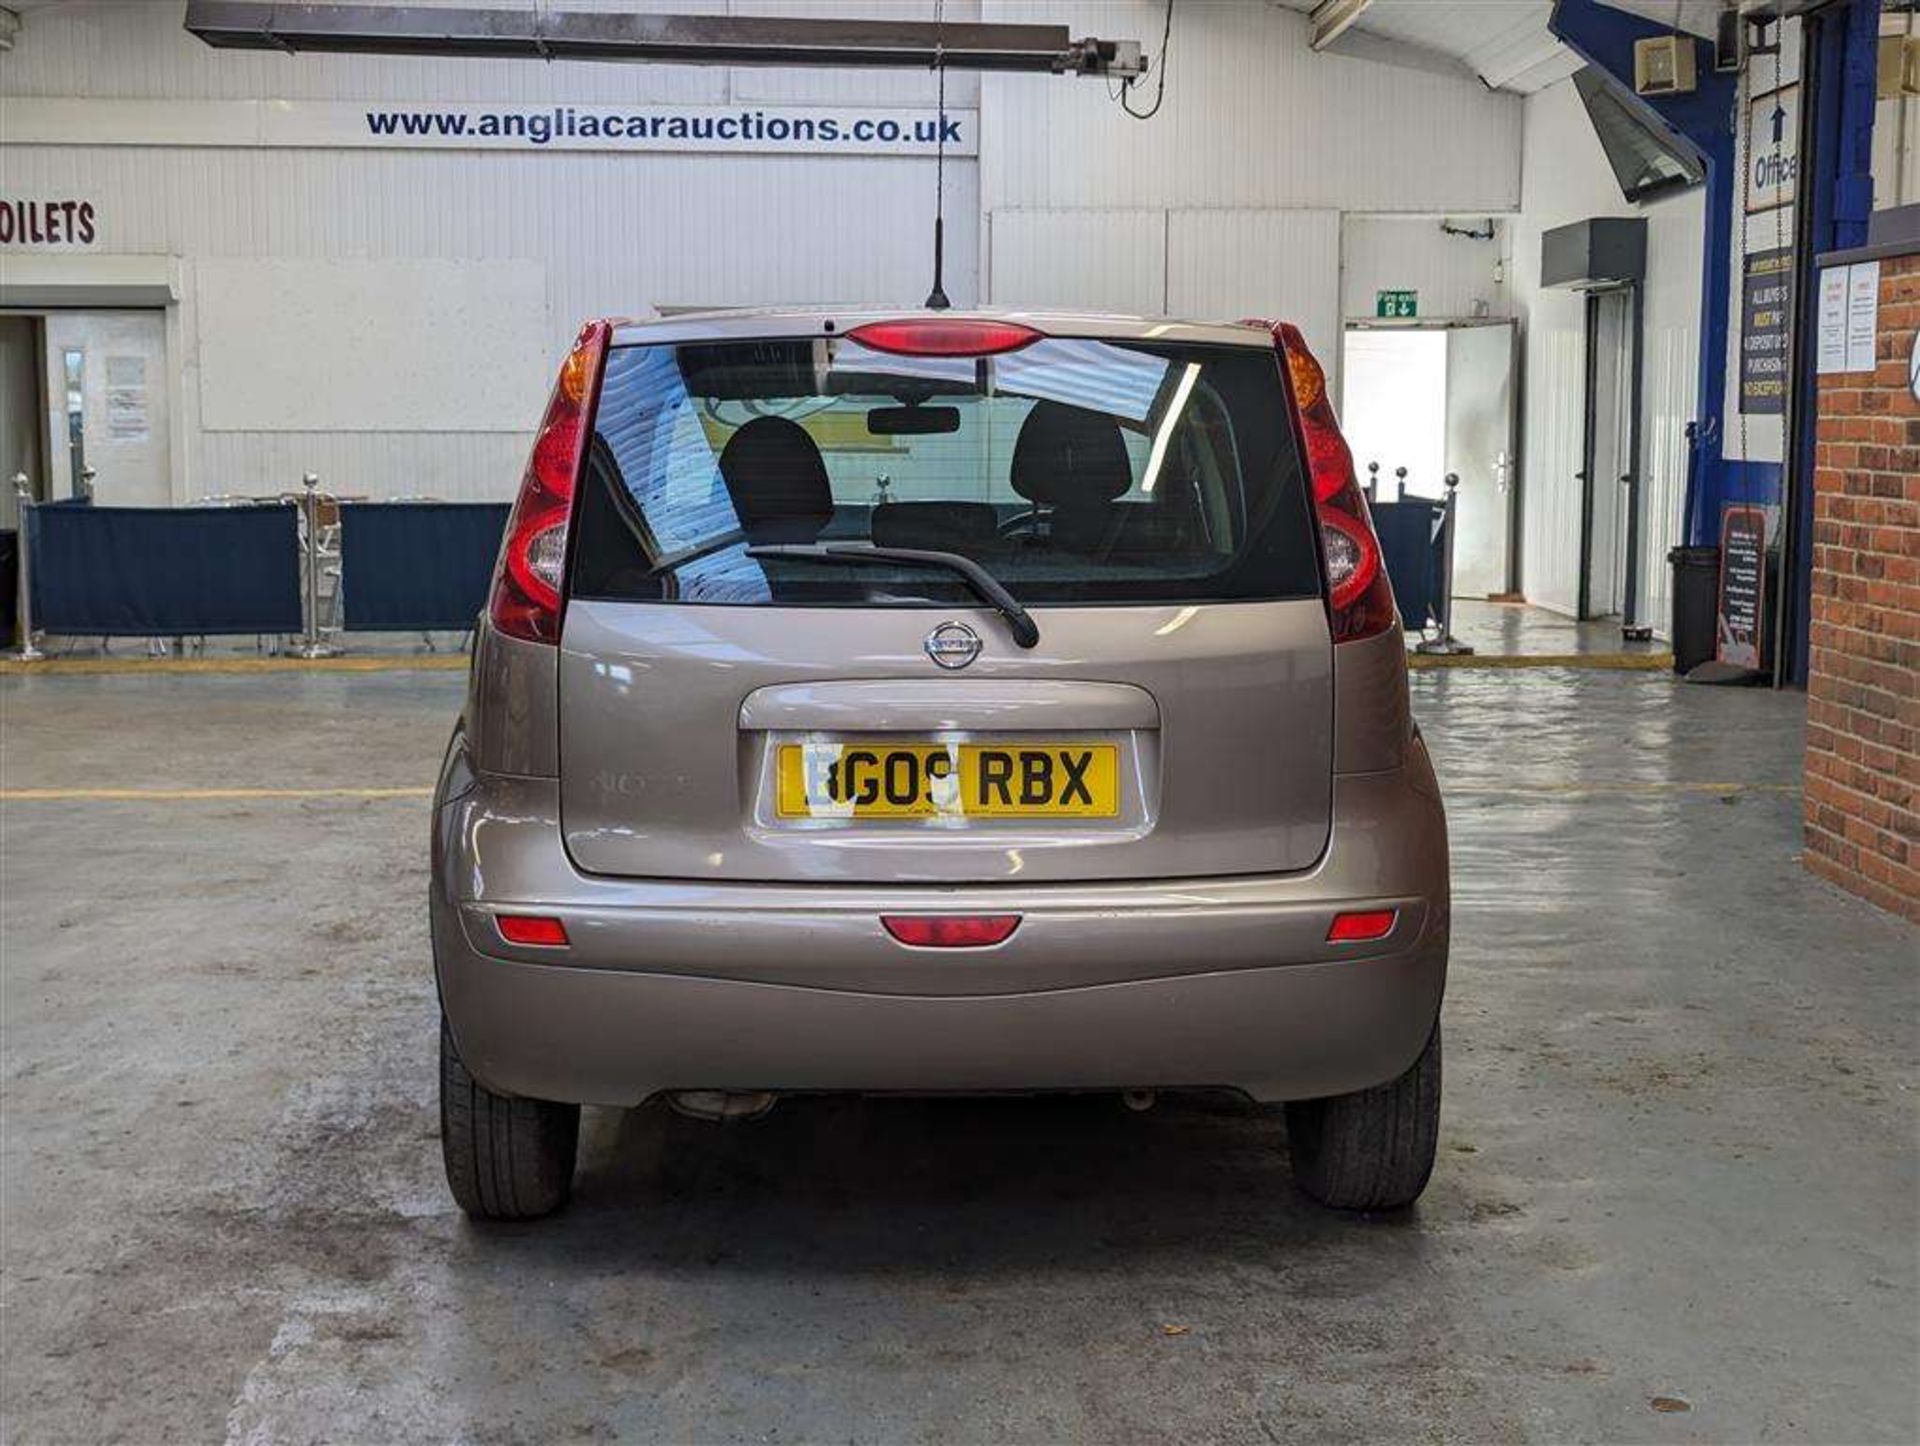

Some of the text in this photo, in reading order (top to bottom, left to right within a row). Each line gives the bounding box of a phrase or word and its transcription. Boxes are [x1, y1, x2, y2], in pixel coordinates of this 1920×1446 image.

[366, 108, 962, 144] www.angliacarauctions.co.uk
[1756, 153, 1797, 188] Office
[979, 751, 1093, 805] RBX
